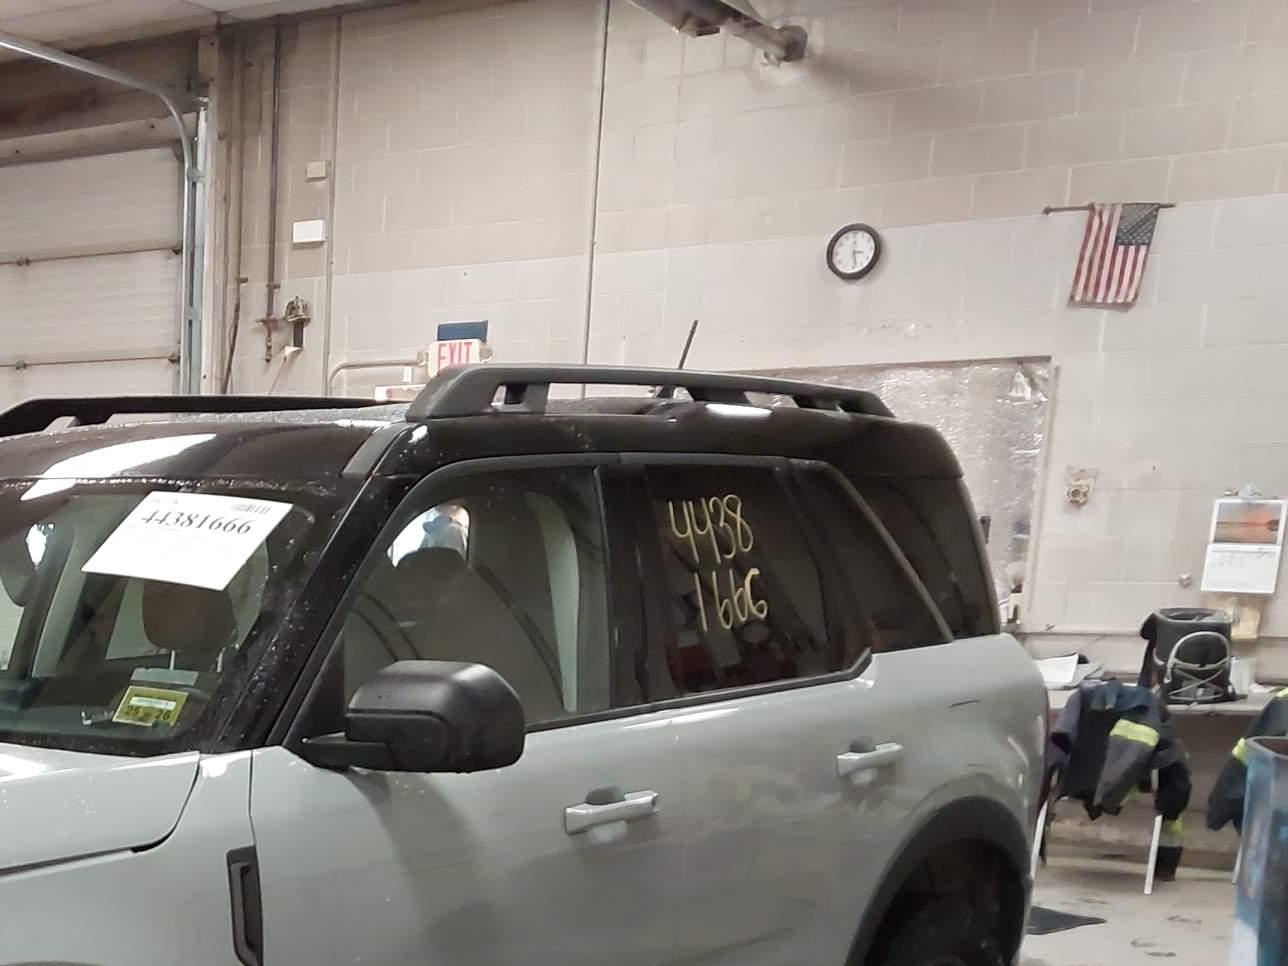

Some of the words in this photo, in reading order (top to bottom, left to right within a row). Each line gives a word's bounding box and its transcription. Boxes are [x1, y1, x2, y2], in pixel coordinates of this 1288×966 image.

[437, 341, 473, 371] EXIT
[141, 510, 257, 535] 44381666
[668, 494, 754, 564] 4438
[693, 567, 768, 632] 1666
